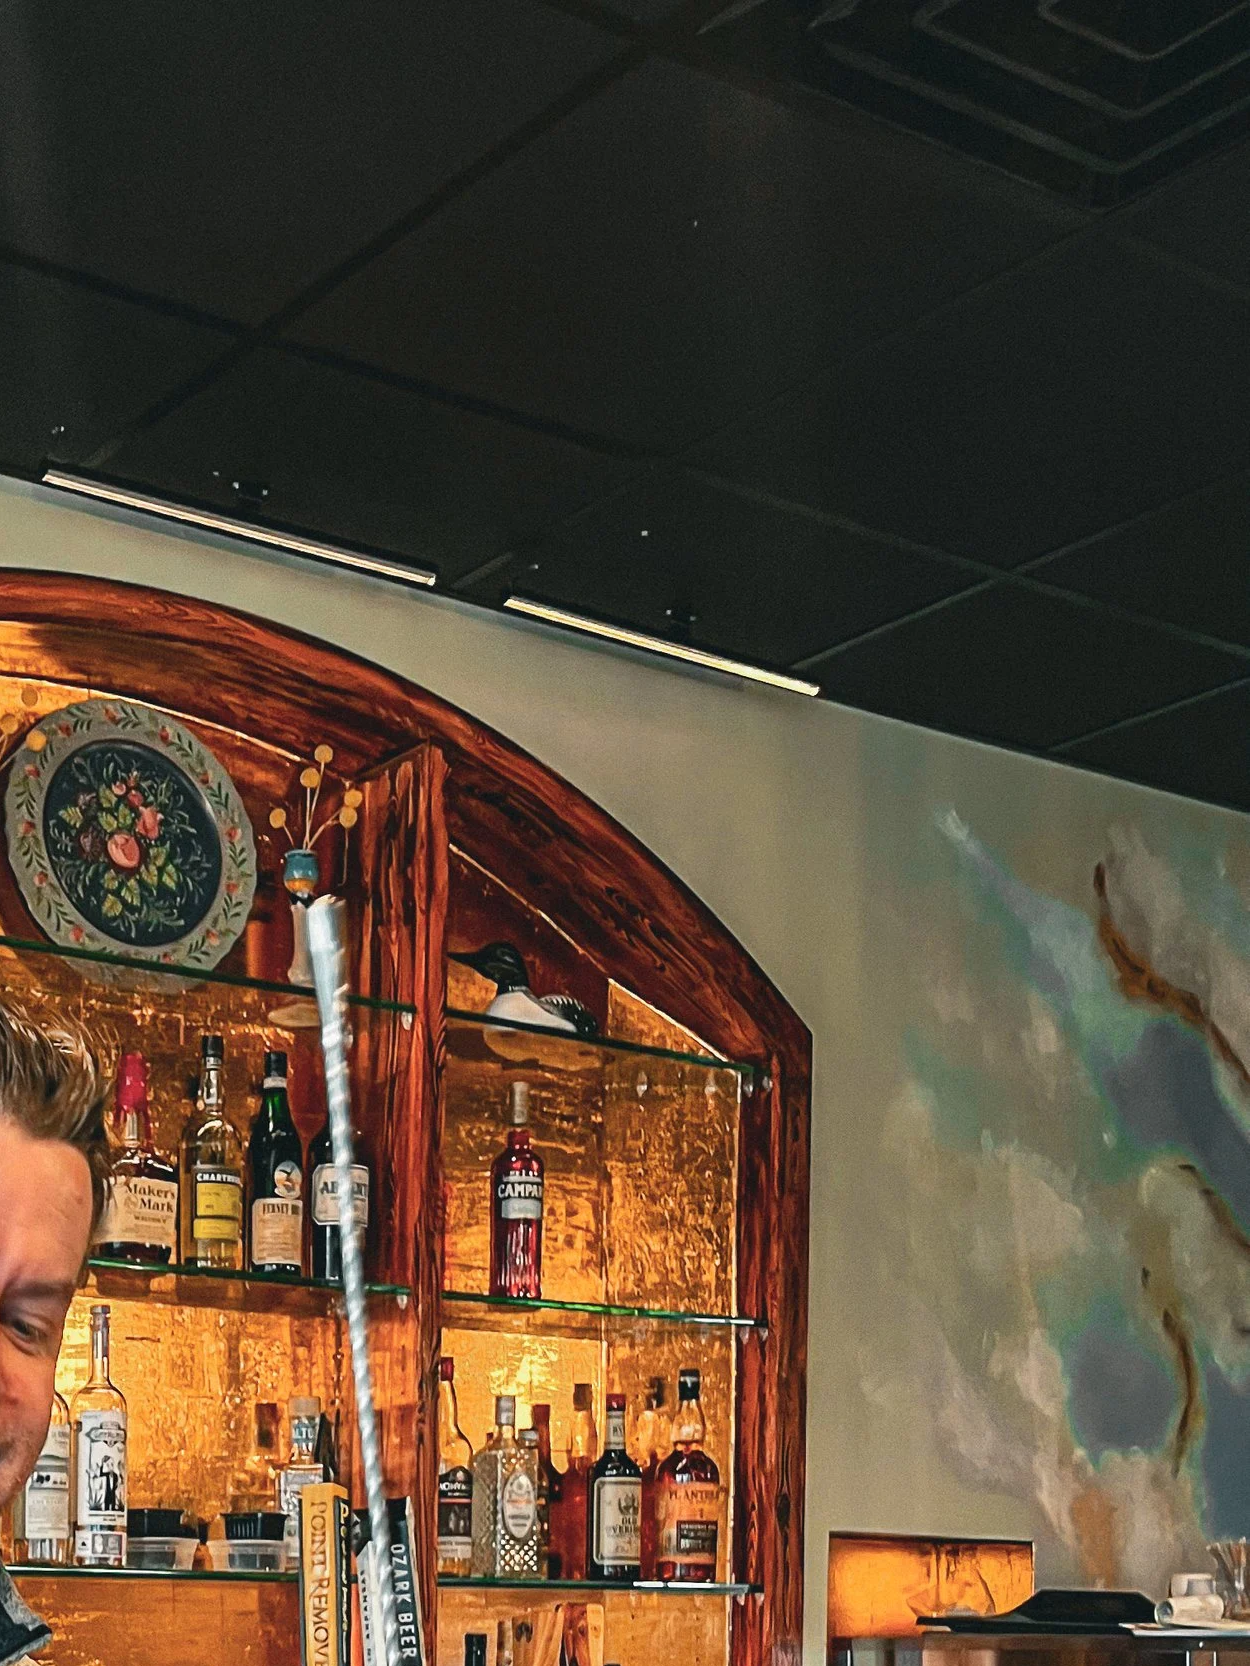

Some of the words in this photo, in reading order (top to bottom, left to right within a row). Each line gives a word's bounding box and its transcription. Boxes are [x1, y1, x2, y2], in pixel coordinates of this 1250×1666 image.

[125, 1184, 175, 1198] Maker's
[138, 1198, 174, 1213] Mark
[310, 1501, 328, 1570] POINT
[390, 1543, 412, 1604] OZARK
[398, 1612, 415, 1659] BEER
